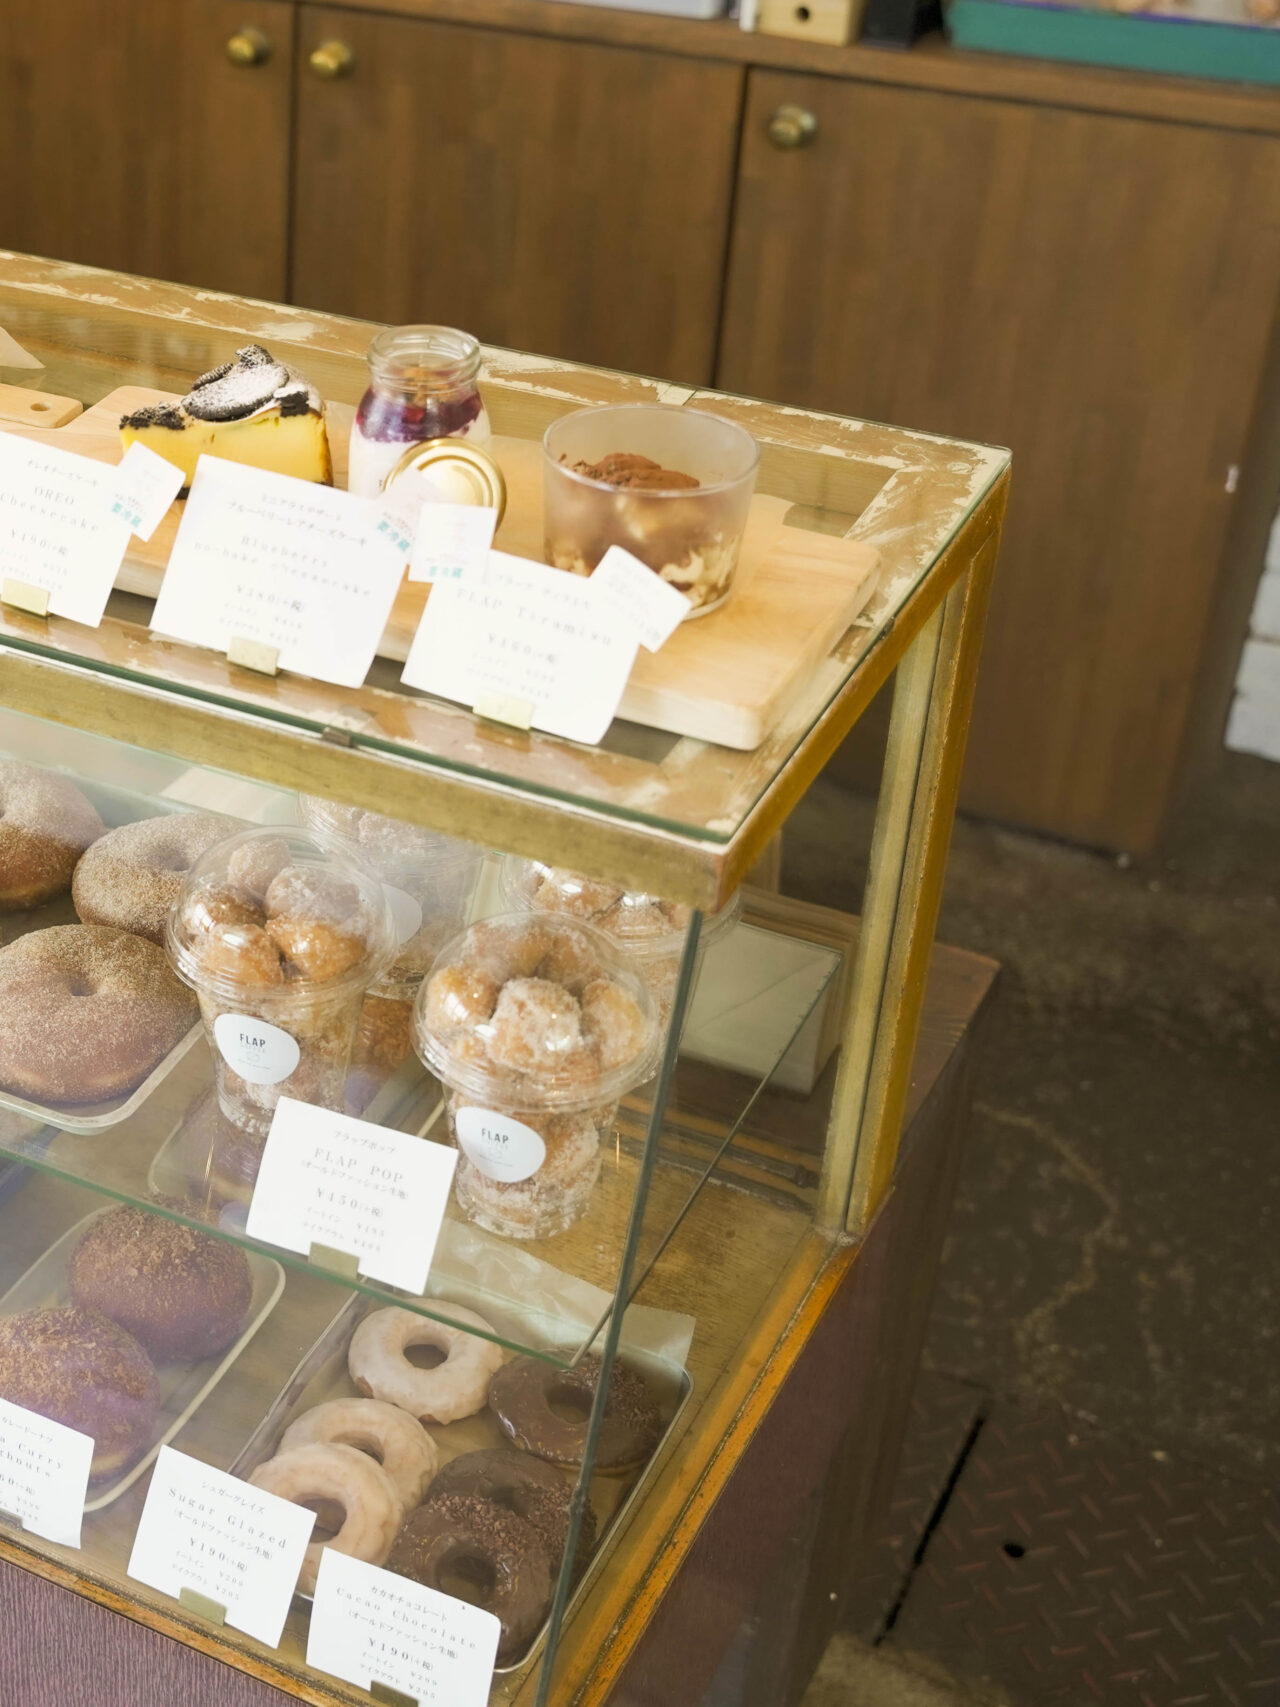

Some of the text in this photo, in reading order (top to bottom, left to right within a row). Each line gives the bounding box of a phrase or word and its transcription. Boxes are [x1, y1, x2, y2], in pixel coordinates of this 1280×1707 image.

[0, 492, 99, 532] Cheesecake
[33, 486, 75, 506] OREO
[240, 535, 329, 569] Blueberry
[456, 588, 612, 647] FLAP Tiramisu
[239, 1033, 266, 1049] FLAP
[481, 1127, 510, 1145] FLAP
[314, 1147, 405, 1184] FLAP POP
[18, 1442, 63, 1471] Curry
[201, 1479, 266, 1516] シュガーグレイズ
[168, 1487, 288, 1550] Sugar Glazed
[336, 1586, 477, 1650] Cacao Chocolate
[371, 1585, 448, 1623] カカオチョコレート
